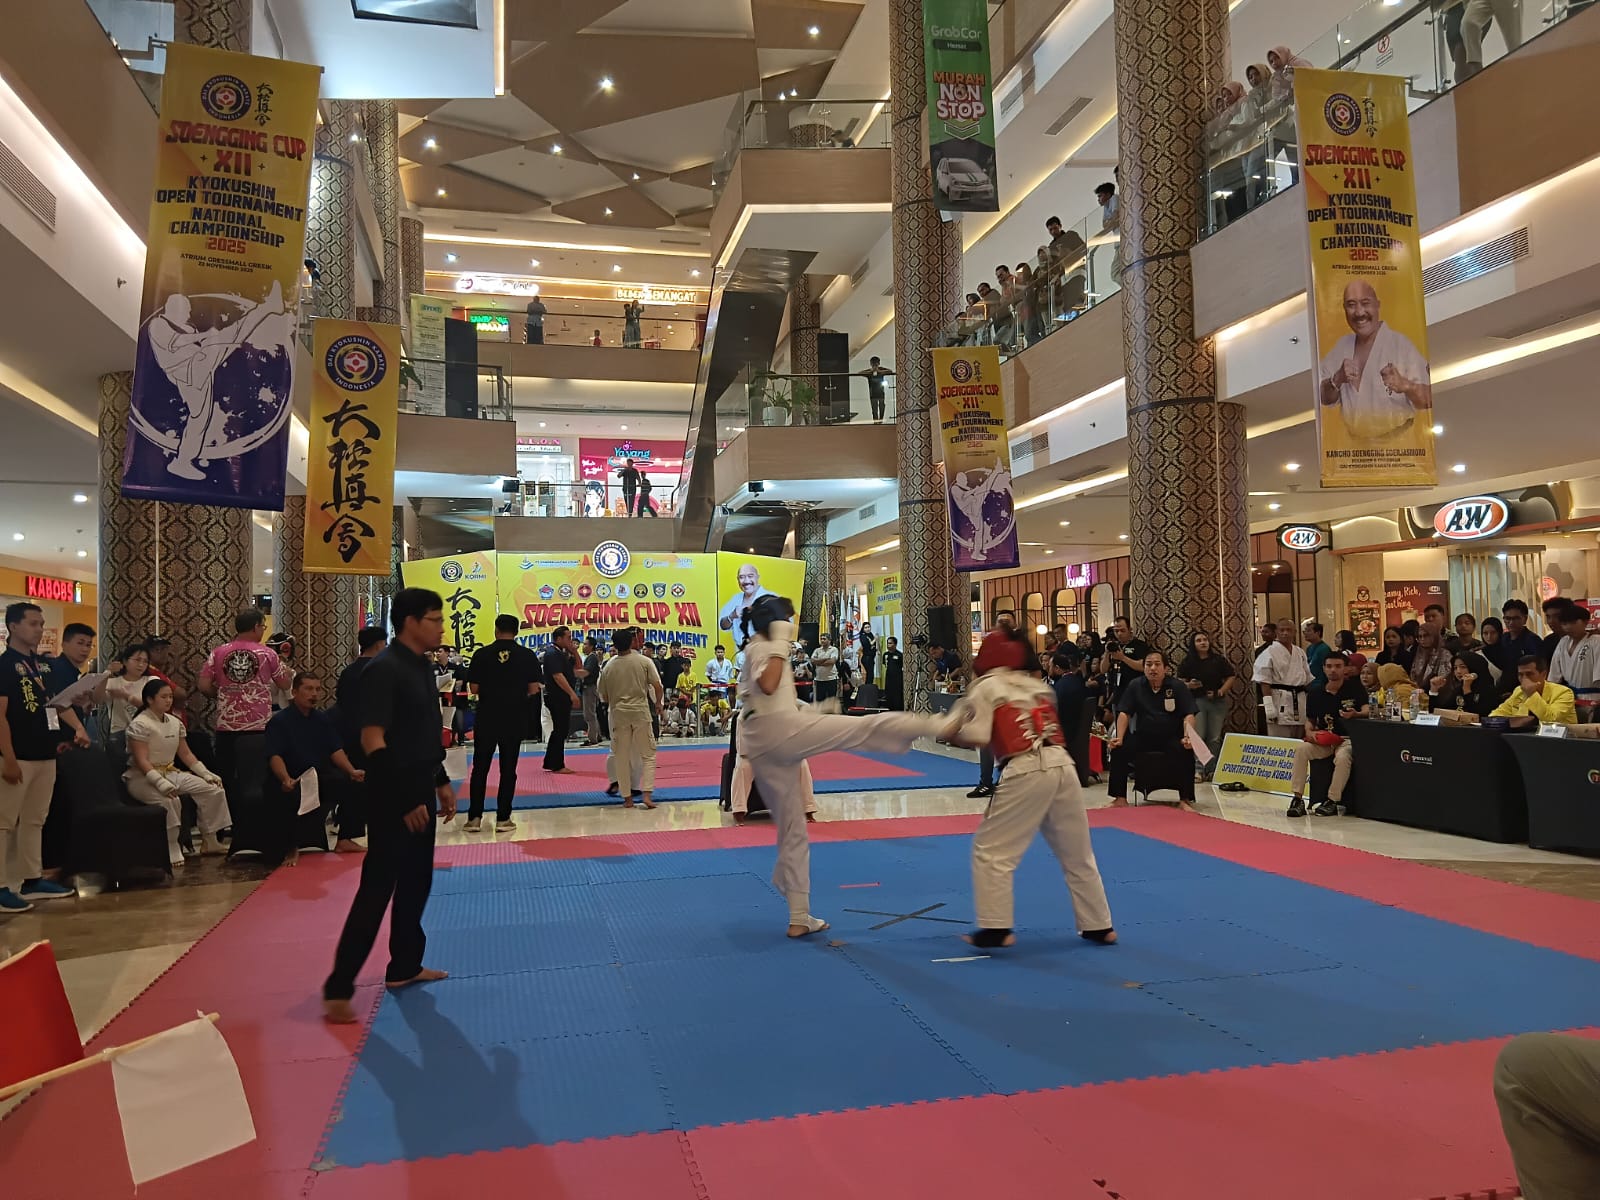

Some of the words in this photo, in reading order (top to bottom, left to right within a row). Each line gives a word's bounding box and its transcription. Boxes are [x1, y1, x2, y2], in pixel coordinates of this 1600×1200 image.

[931, 25, 982, 39] GrabCar
[933, 73, 985, 86] MURAH
[940, 84, 981, 101] NON
[937, 102, 985, 119] STOP
[166, 120, 268, 153] SOENGGING
[273, 135, 306, 161] CUP
[214, 150, 251, 176] XII
[1305, 144, 1380, 166] SOENGGING
[1382, 149, 1406, 171] CUP
[1343, 168, 1372, 189] XII
[189, 176, 276, 200] KYOKUSHIN
[157, 189, 197, 203] OPEN
[203, 191, 303, 222] TOURNAMENT
[1328, 193, 1392, 209] KYOKUSHIN
[192, 207, 266, 229] NATIONAL
[1308, 207, 1336, 223] OPEN
[1341, 207, 1413, 227] TOURNAMENT
[171, 221, 285, 247] CHAMPIONSHIP
[1335, 223, 1390, 236] NATIONAL
[208, 237, 247, 254] 2025
[1320, 236, 1403, 251] CHAMPIONSHIP
[181, 253, 206, 261] ATRIUM
[1350, 249, 1379, 261] 2025
[332, 336, 370, 353] KYOKUSHIN
[372, 345, 385, 370] KARATE
[336, 377, 375, 390] INDONESIA
[984, 384, 999, 397] CUP
[963, 397, 979, 408] XII
[942, 421, 959, 430] OPEN
[961, 419, 1003, 427] TOURNAMENT
[951, 433, 998, 444] CHAMPIONSHIP
[614, 446, 650, 462] Yayang
[27, 575, 74, 602] KABOBS
[520, 602, 629, 629] SOENGGING
[634, 602, 670, 625] CUP
[675, 602, 702, 627] XII
[1243, 744, 1267, 755] MENANG
[1222, 763, 1256, 775] SPORTIFITAS
[1241, 755, 1260, 764] KALAH
[1260, 757, 1277, 767] Bukan
